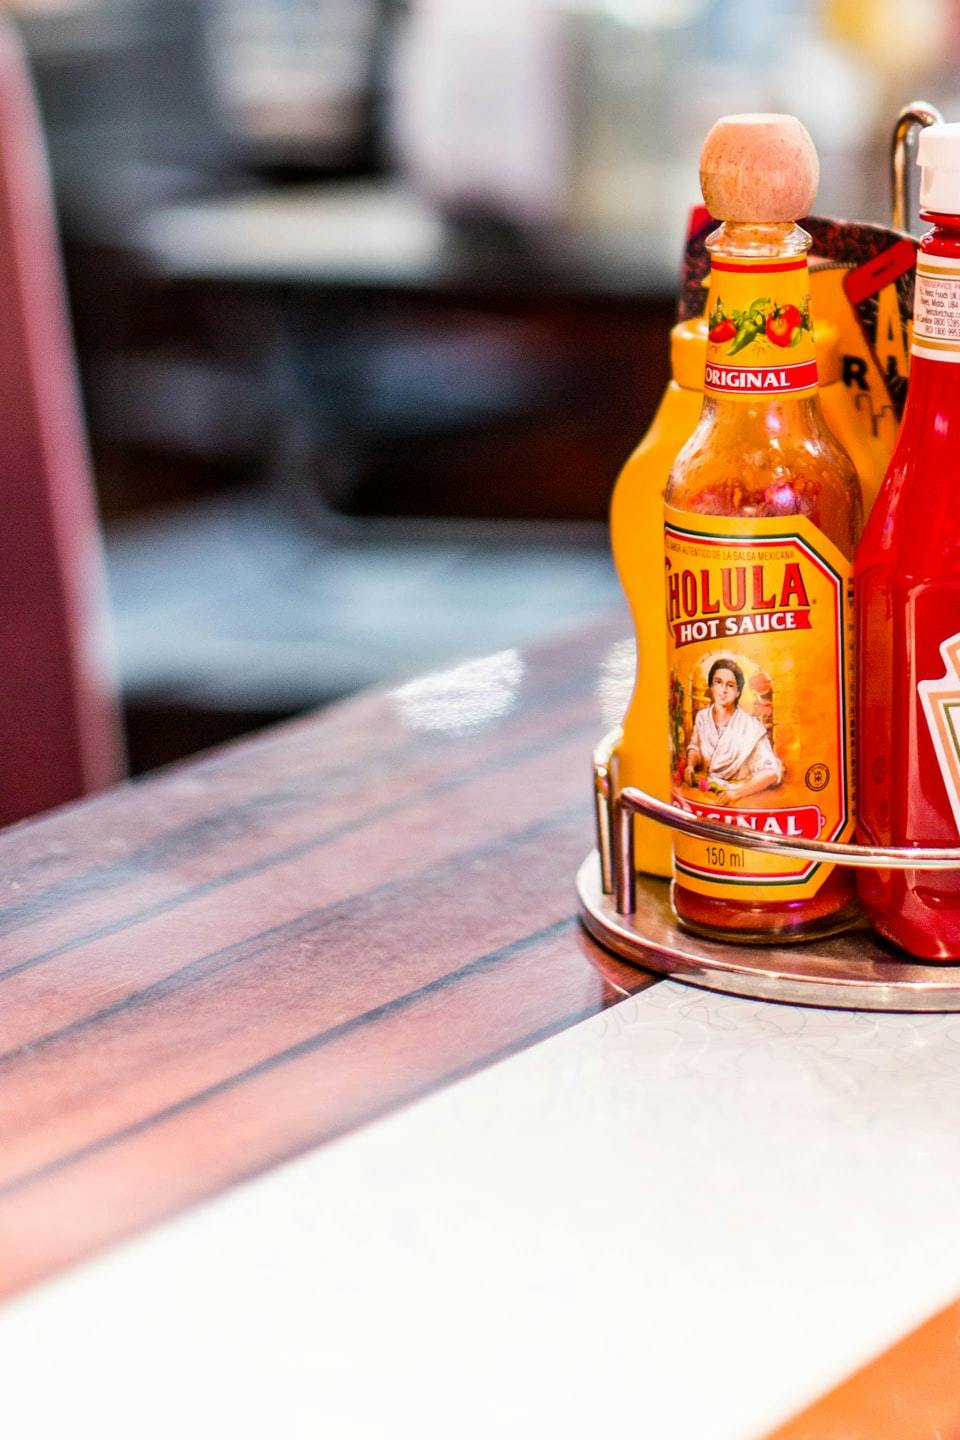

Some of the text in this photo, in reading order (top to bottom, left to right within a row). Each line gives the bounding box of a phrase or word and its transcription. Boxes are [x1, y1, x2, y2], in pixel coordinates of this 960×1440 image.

[705, 369, 790, 388] ORIGINAL
[722, 550, 731, 561] LA
[732, 551, 756, 561] SALSA
[757, 549, 796, 561] MEXICANA
[681, 611, 797, 642] HOT SAUCE
[673, 798, 804, 836] INAL
[705, 847, 745, 868] 150 ml
